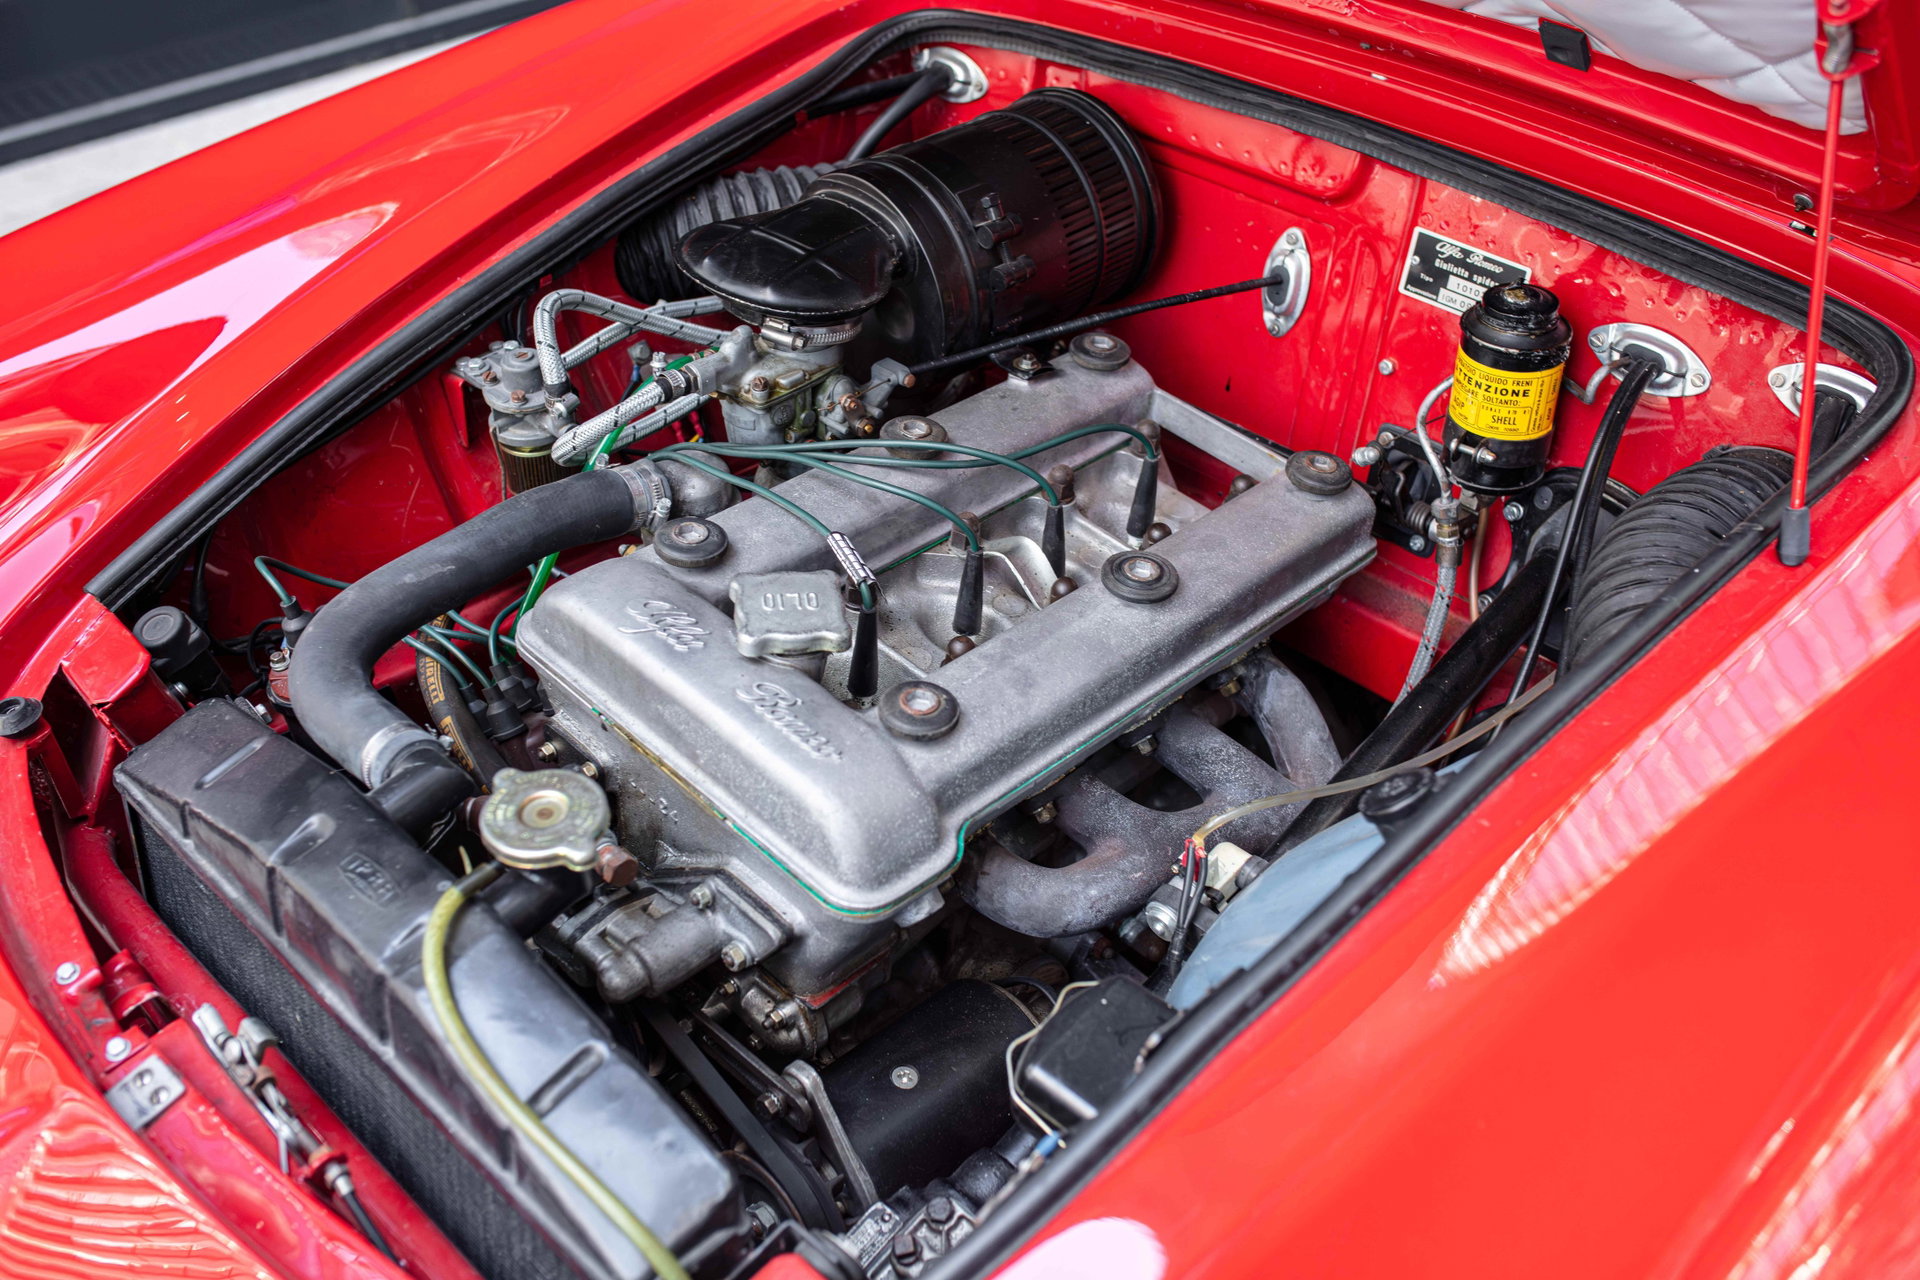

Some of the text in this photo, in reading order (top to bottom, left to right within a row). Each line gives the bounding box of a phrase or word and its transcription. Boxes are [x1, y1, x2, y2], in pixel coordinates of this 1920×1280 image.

[1434, 259, 1469, 278] Giulietta
[1435, 241, 1504, 273] Alfa Romeo
[1419, 272, 1485, 298] Tipo 1010
[1478, 372, 1508, 387] LIQUIDO
[1512, 379, 1533, 388] FRENI
[1491, 414, 1517, 426] SHELL
[762, 591, 819, 612] OLIO
[618, 600, 712, 653] Alfa
[736, 681, 843, 763] Romeo
